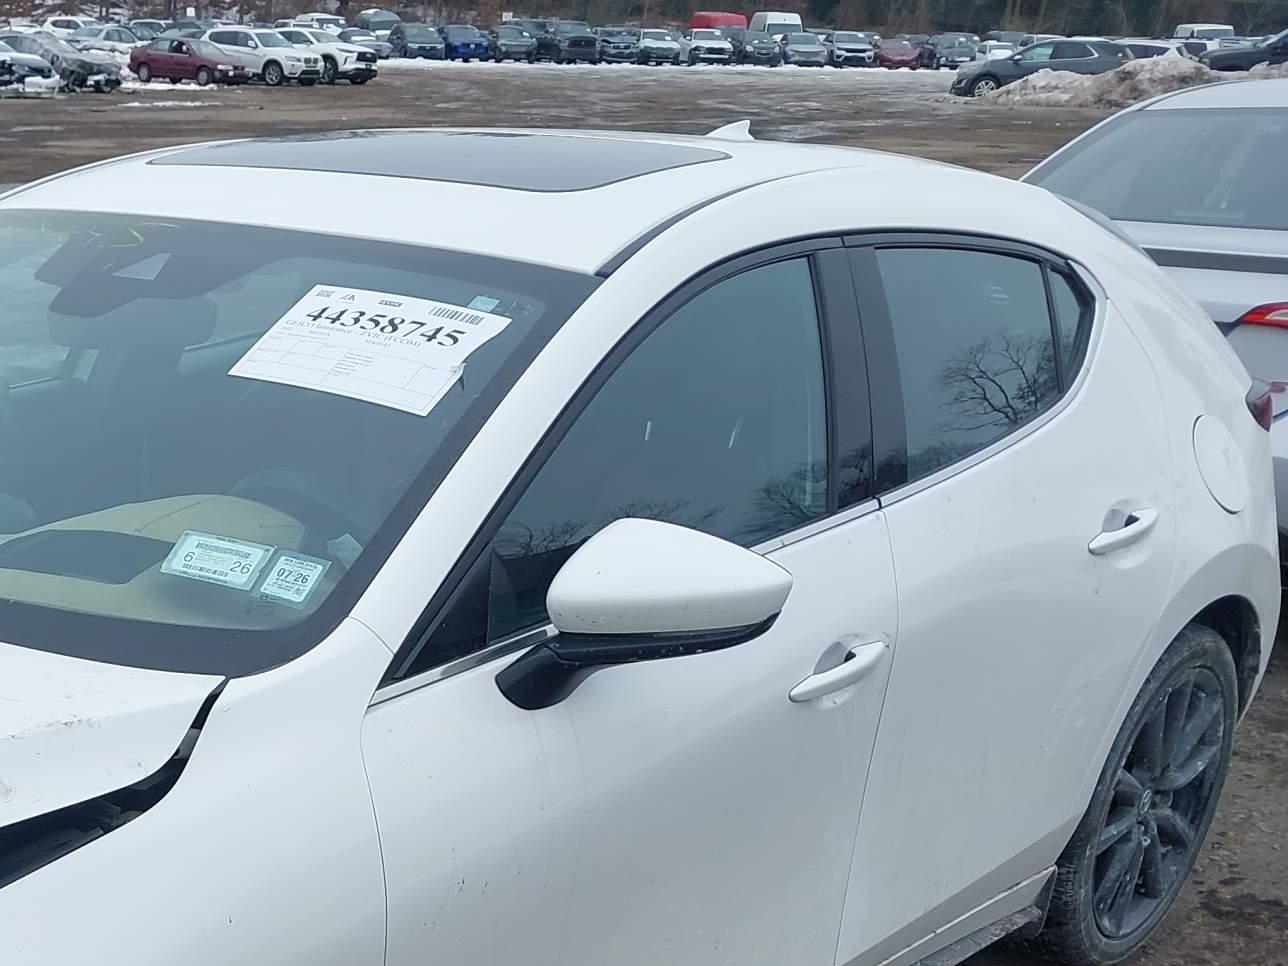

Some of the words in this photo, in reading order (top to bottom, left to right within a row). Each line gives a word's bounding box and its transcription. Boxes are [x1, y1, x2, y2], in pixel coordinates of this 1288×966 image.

[306, 306, 466, 347] 44358745
[183, 551, 196, 563] 6
[229, 560, 253, 575] 26
[277, 567, 293, 579] 07
[293, 572, 310, 584] 26
